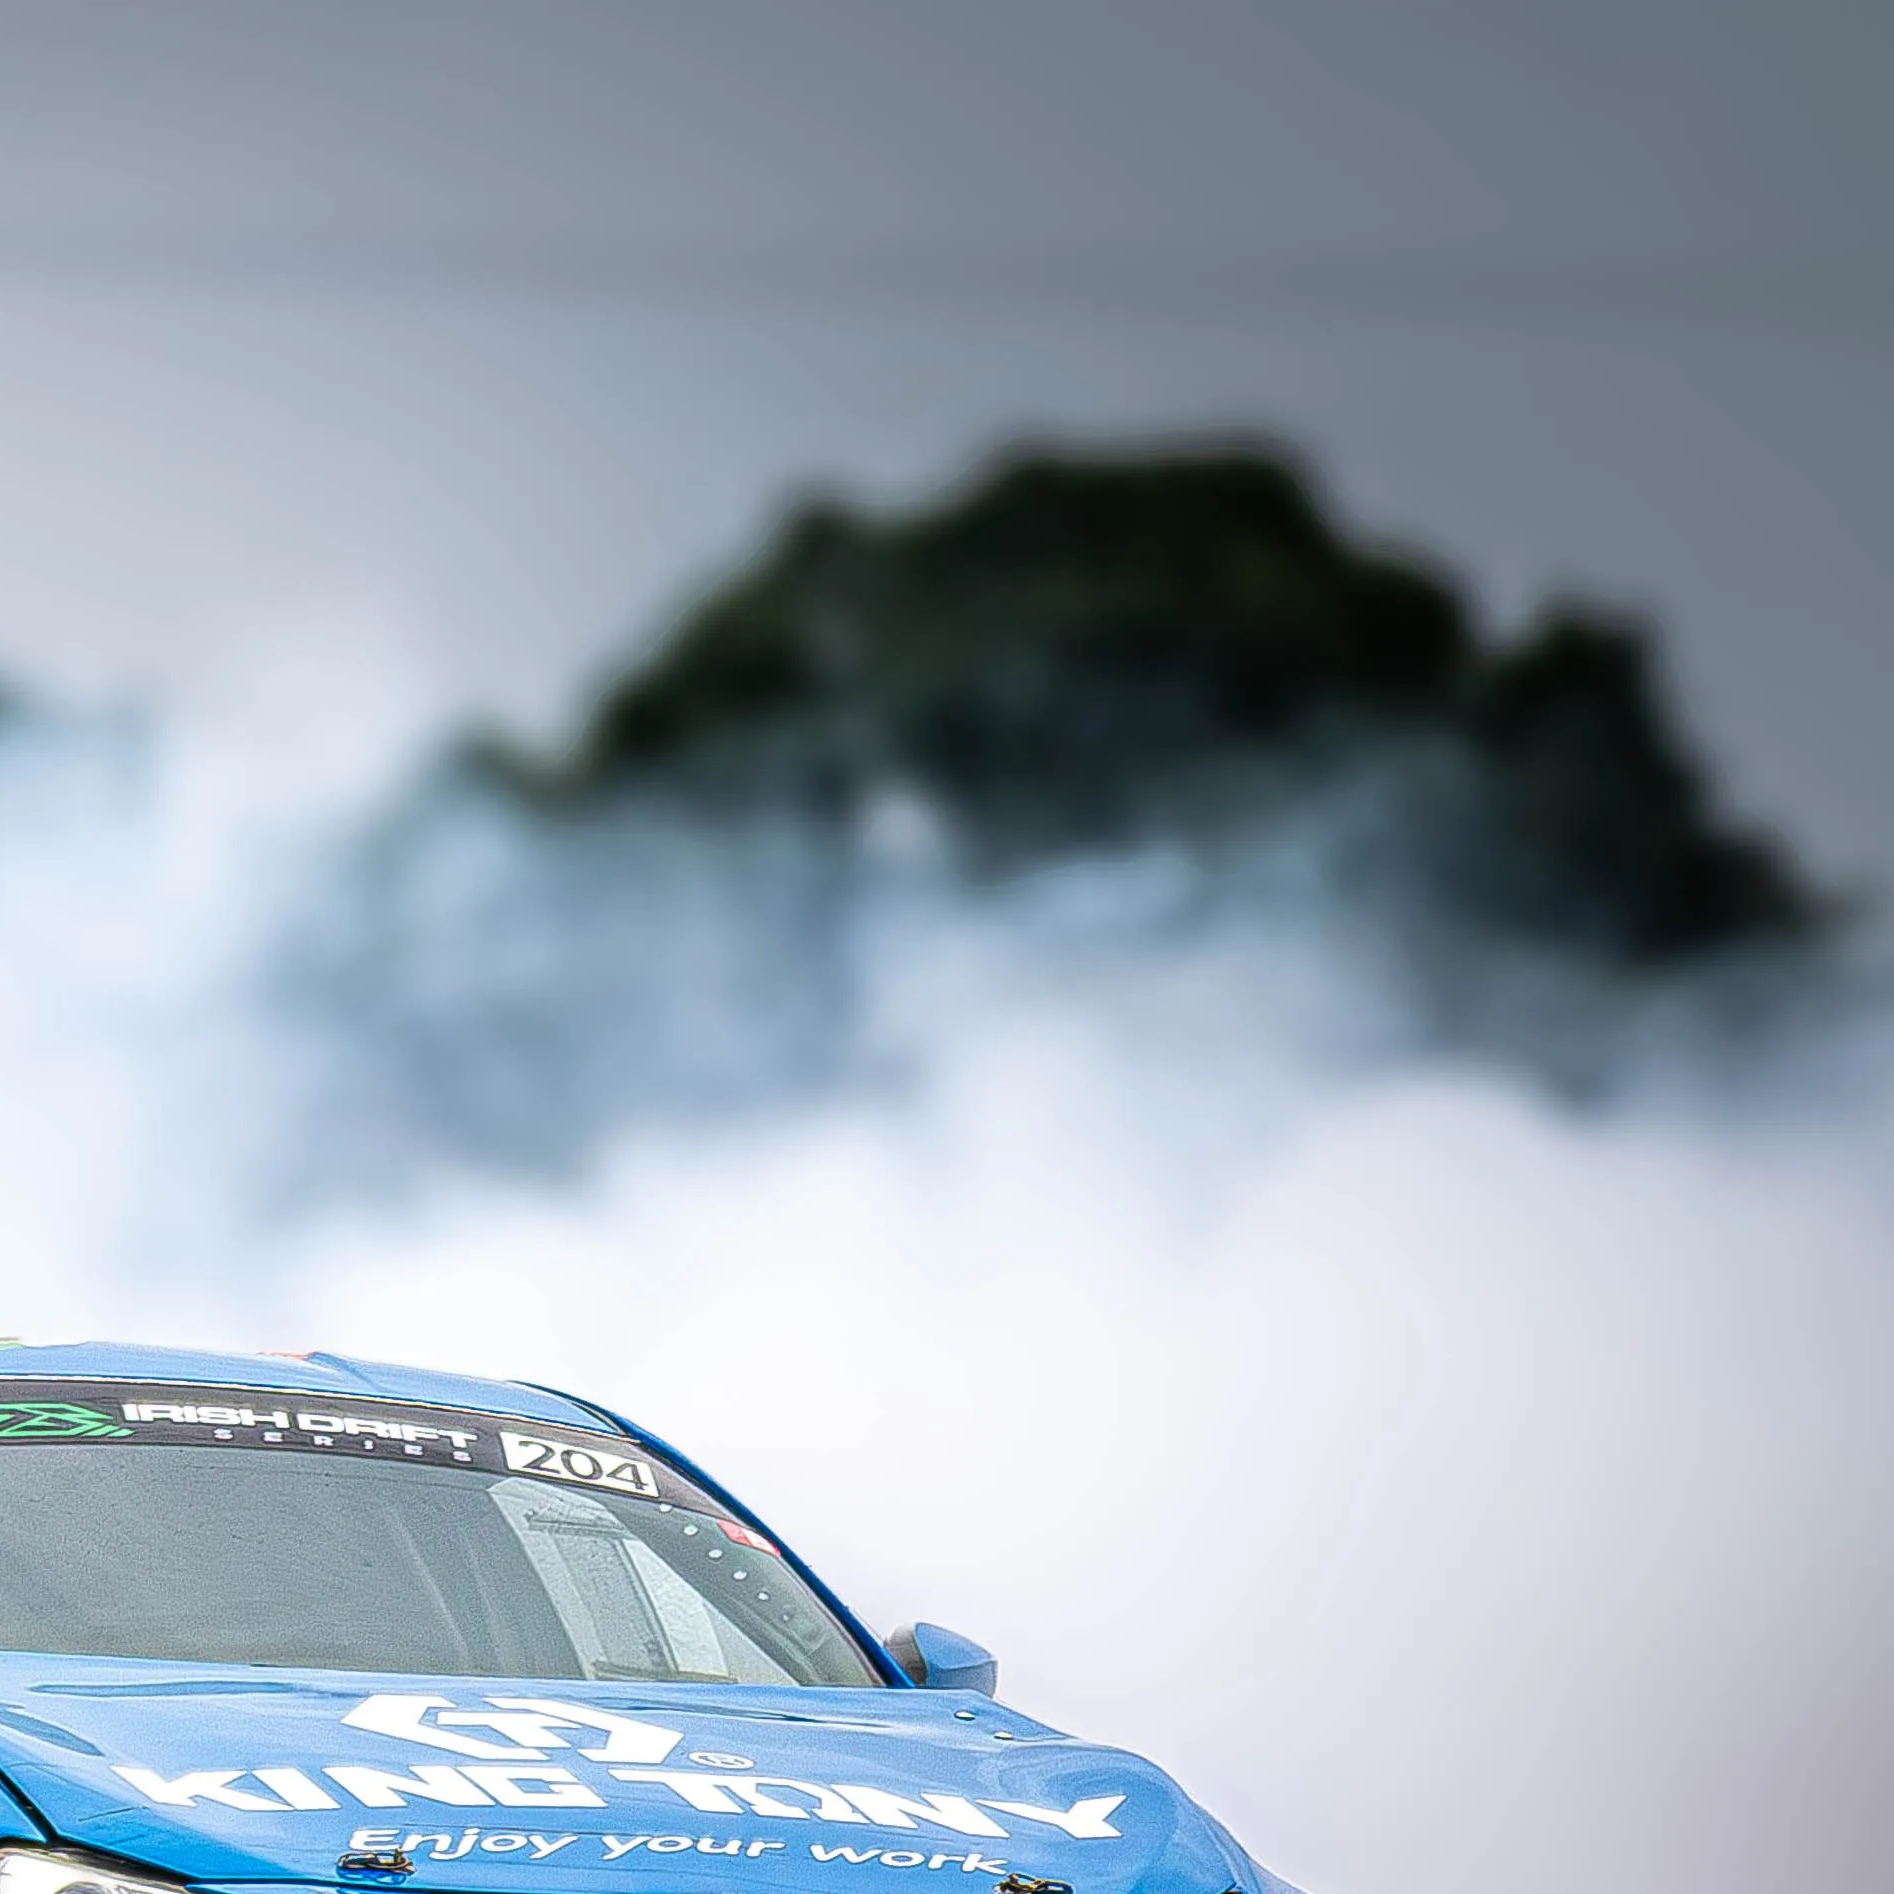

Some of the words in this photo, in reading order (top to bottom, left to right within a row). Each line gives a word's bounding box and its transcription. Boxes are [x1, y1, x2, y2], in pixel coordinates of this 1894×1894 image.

[121, 1403, 290, 1429] IRISH
[296, 1413, 477, 1448] DRIFT
[214, 1428, 473, 1462] SERIES
[517, 1441, 649, 1491] 204
[110, 1765, 608, 1811] KING
[350, 1826, 577, 1859] Enjoy
[601, 1833, 785, 1861] your
[809, 1843, 1011, 1875] work
